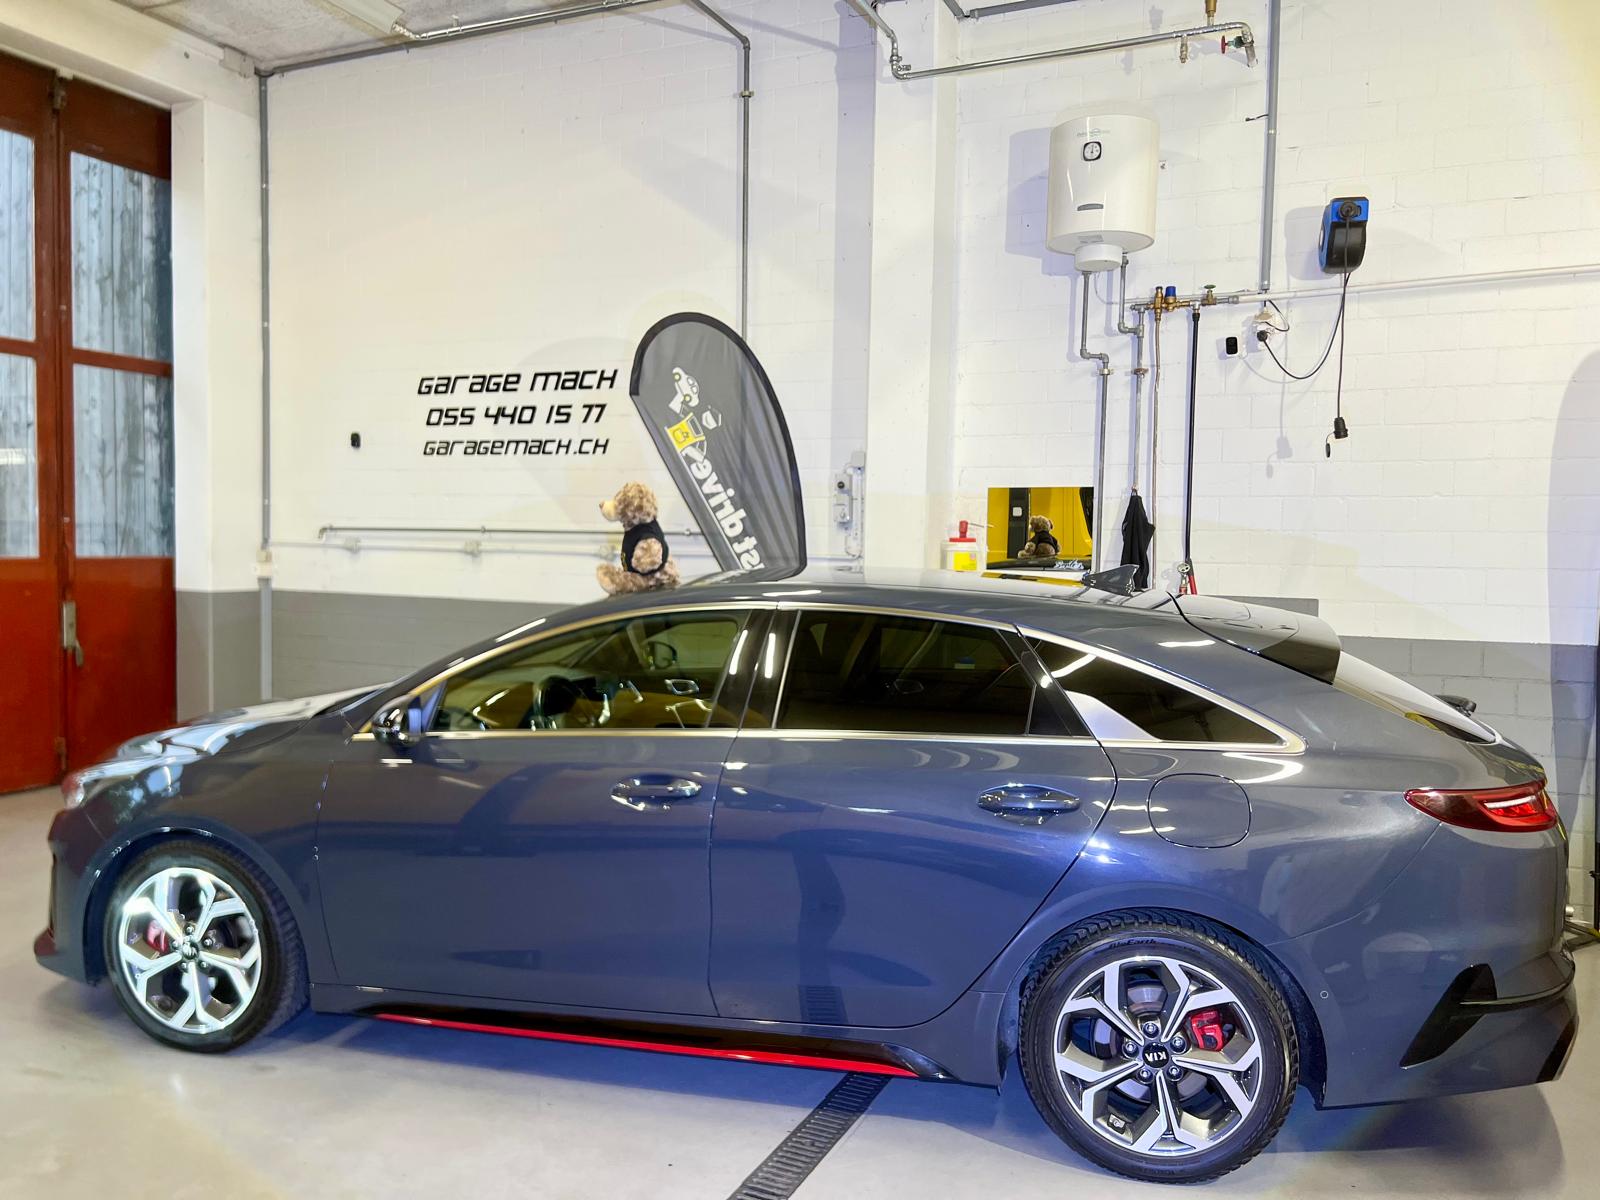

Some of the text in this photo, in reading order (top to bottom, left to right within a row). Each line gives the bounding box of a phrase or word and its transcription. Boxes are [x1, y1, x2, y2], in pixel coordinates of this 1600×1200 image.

[426, 404, 607, 426] 055 440 15 77
[1144, 1051, 1167, 1062] KIA
